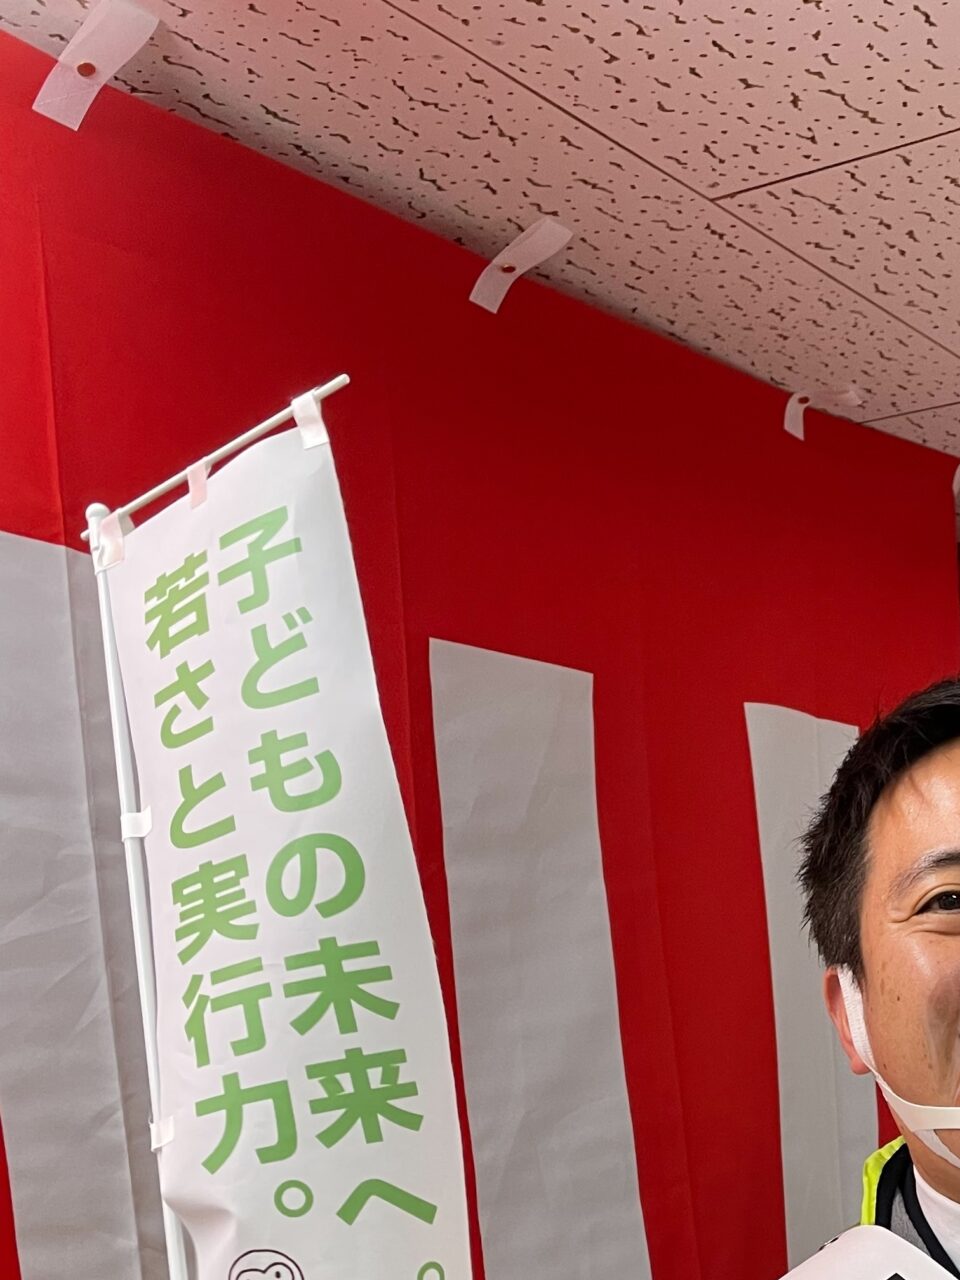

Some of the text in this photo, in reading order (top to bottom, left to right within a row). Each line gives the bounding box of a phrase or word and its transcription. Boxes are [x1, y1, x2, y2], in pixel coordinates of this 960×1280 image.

[143, 548, 316, 1222] 若さと実行力。
